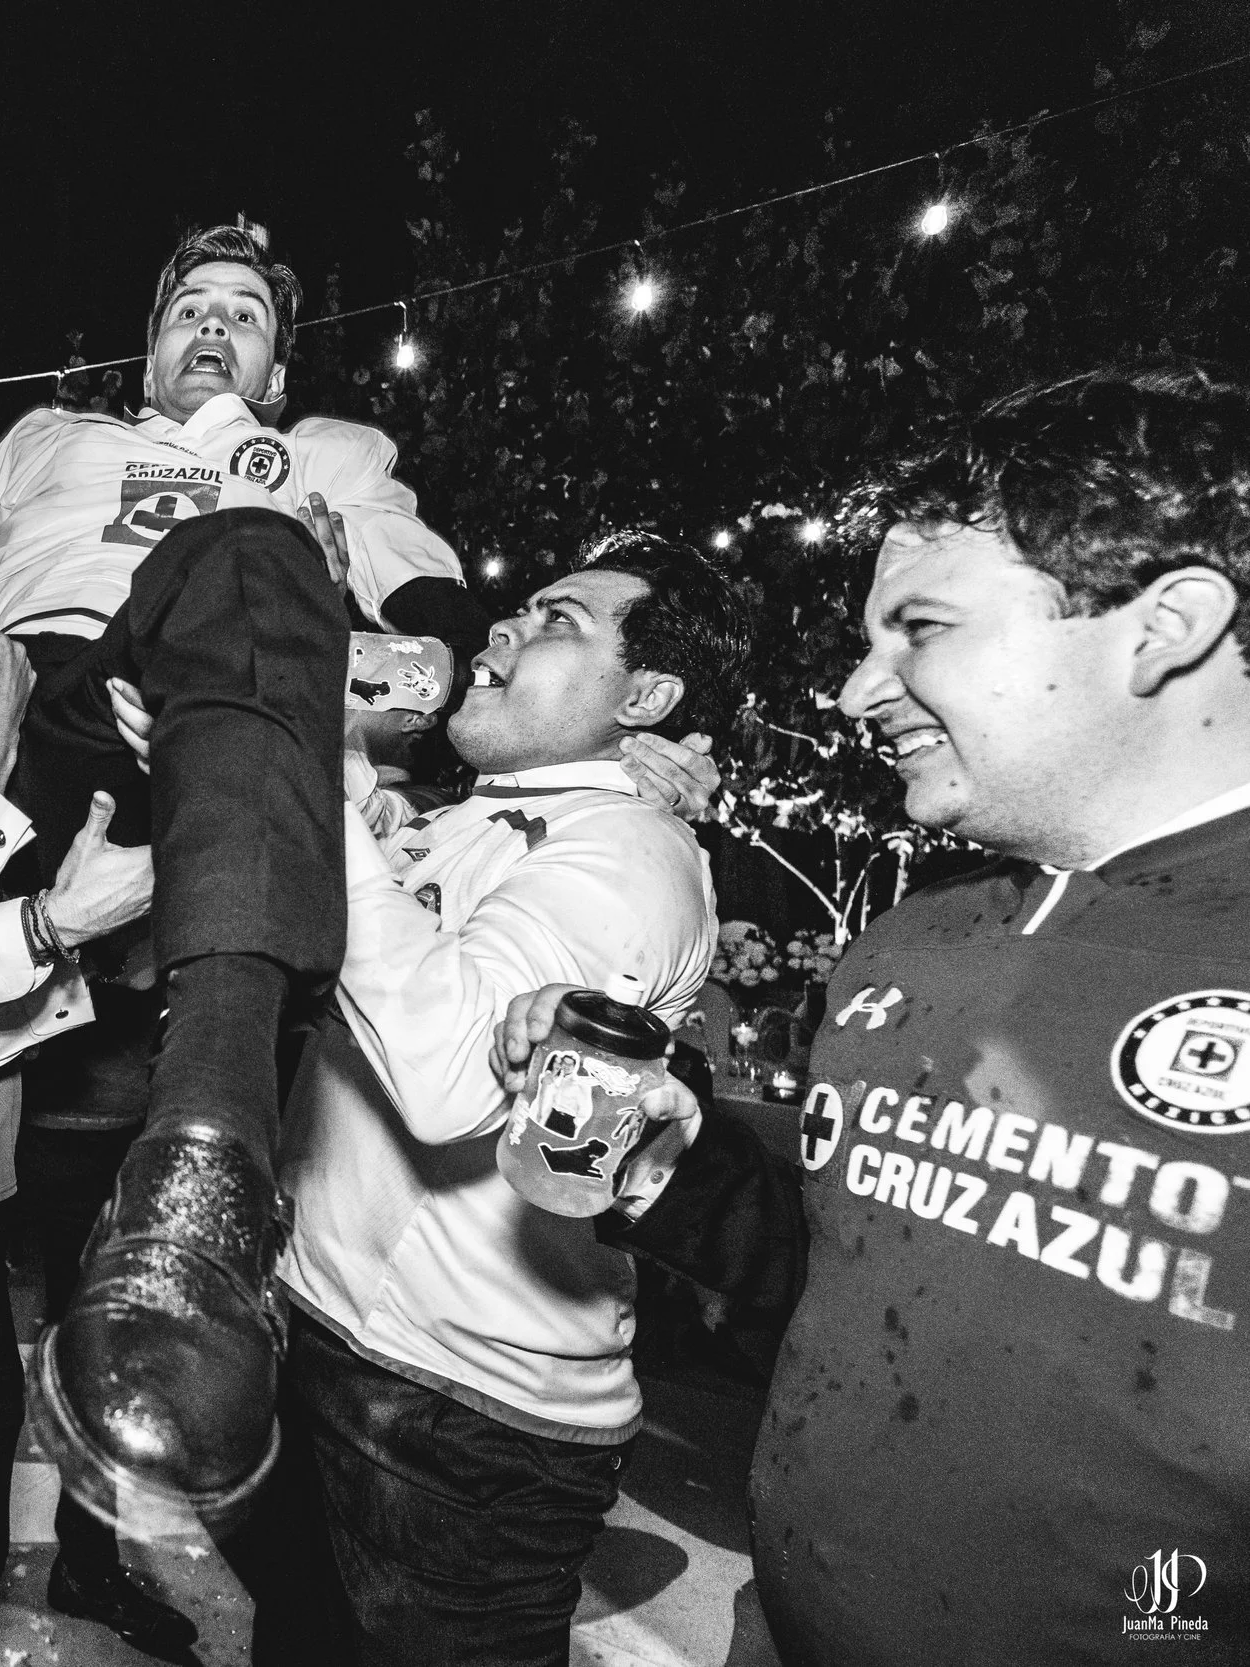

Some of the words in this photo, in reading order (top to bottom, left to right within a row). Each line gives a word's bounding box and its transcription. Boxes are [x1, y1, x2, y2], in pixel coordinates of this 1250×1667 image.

[846, 1144, 988, 1235] CRUZ
[986, 1190, 1236, 1331] AZUL
[860, 1086, 1230, 1235] CEMENTO
